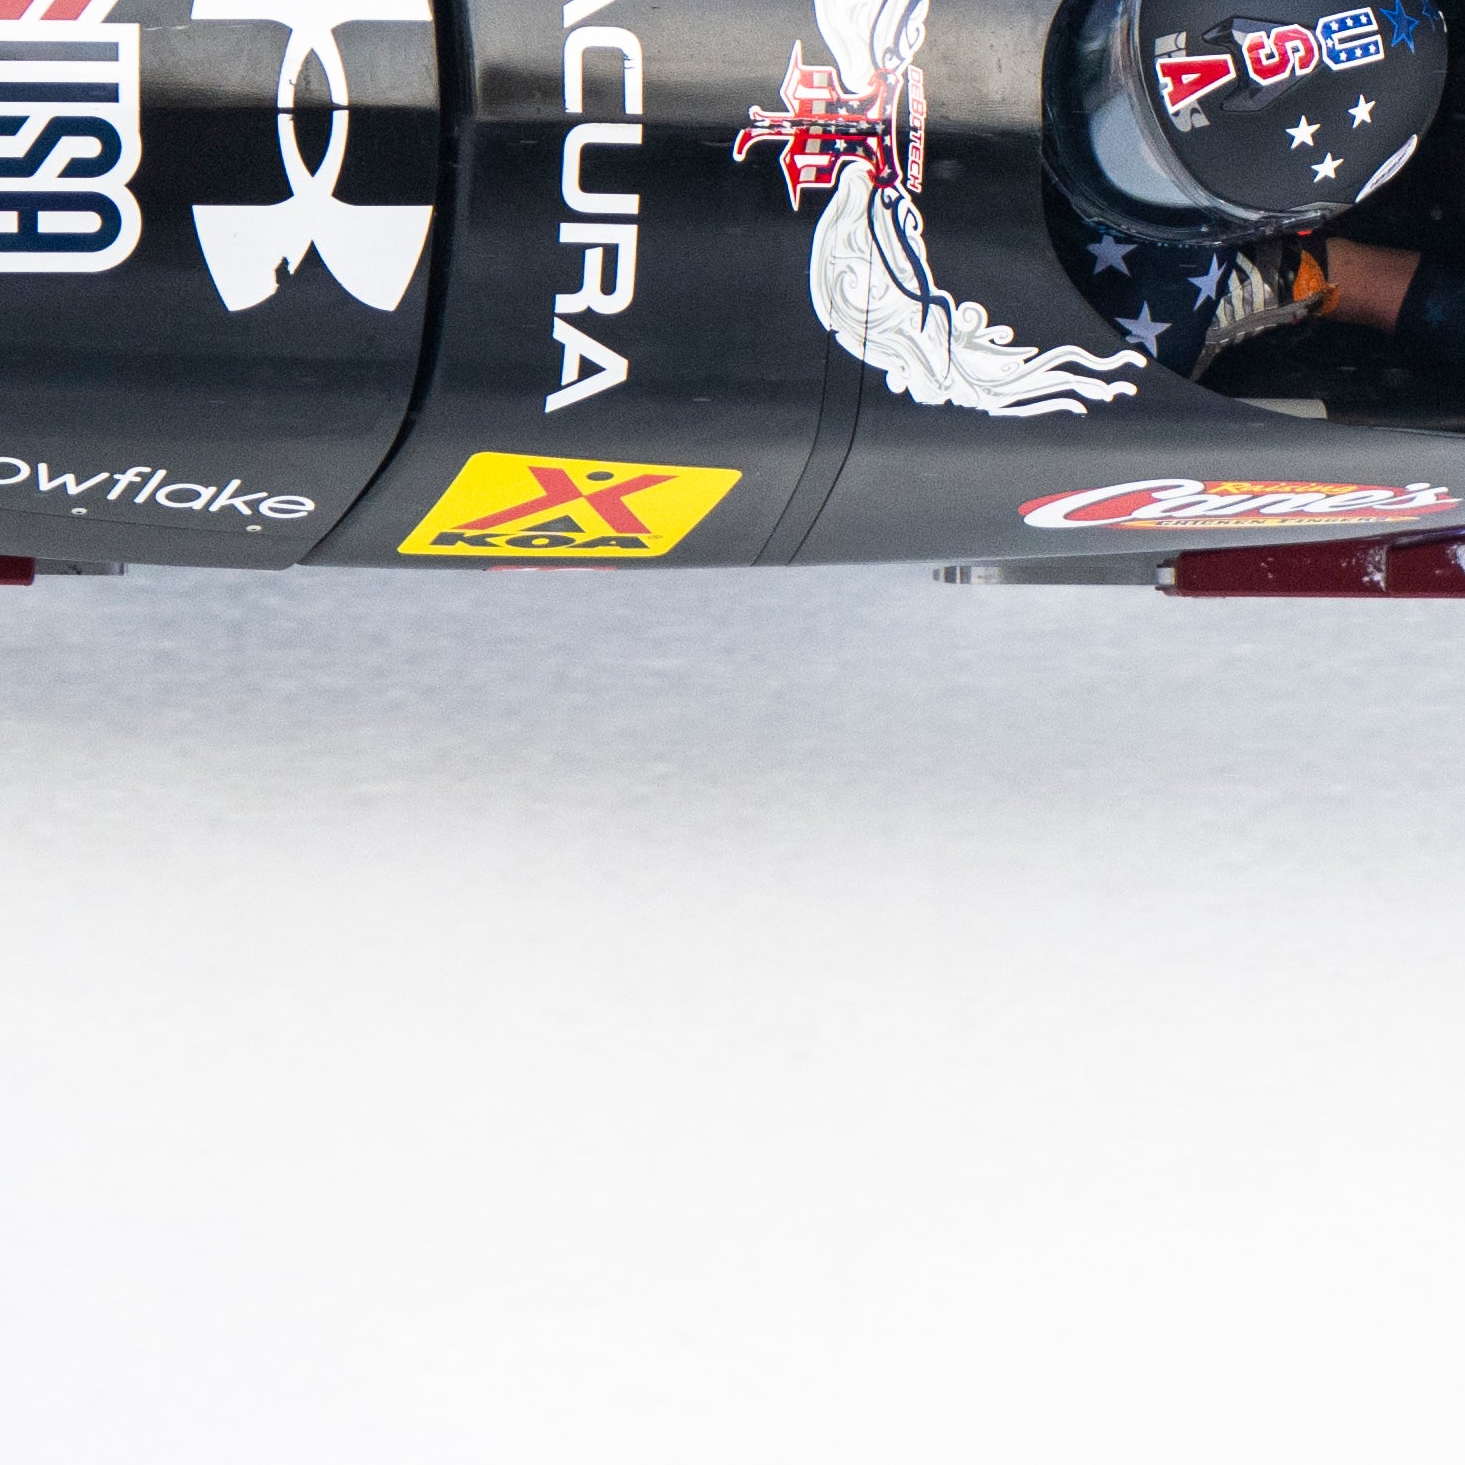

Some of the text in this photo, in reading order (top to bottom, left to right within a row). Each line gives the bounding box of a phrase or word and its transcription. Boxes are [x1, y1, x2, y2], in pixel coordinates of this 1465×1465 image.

[1157, 6, 1385, 114] USA
[1023, 478, 1463, 528] Cane's
[1207, 481, 1359, 496] Raising
[429, 532, 651, 550] KOA
